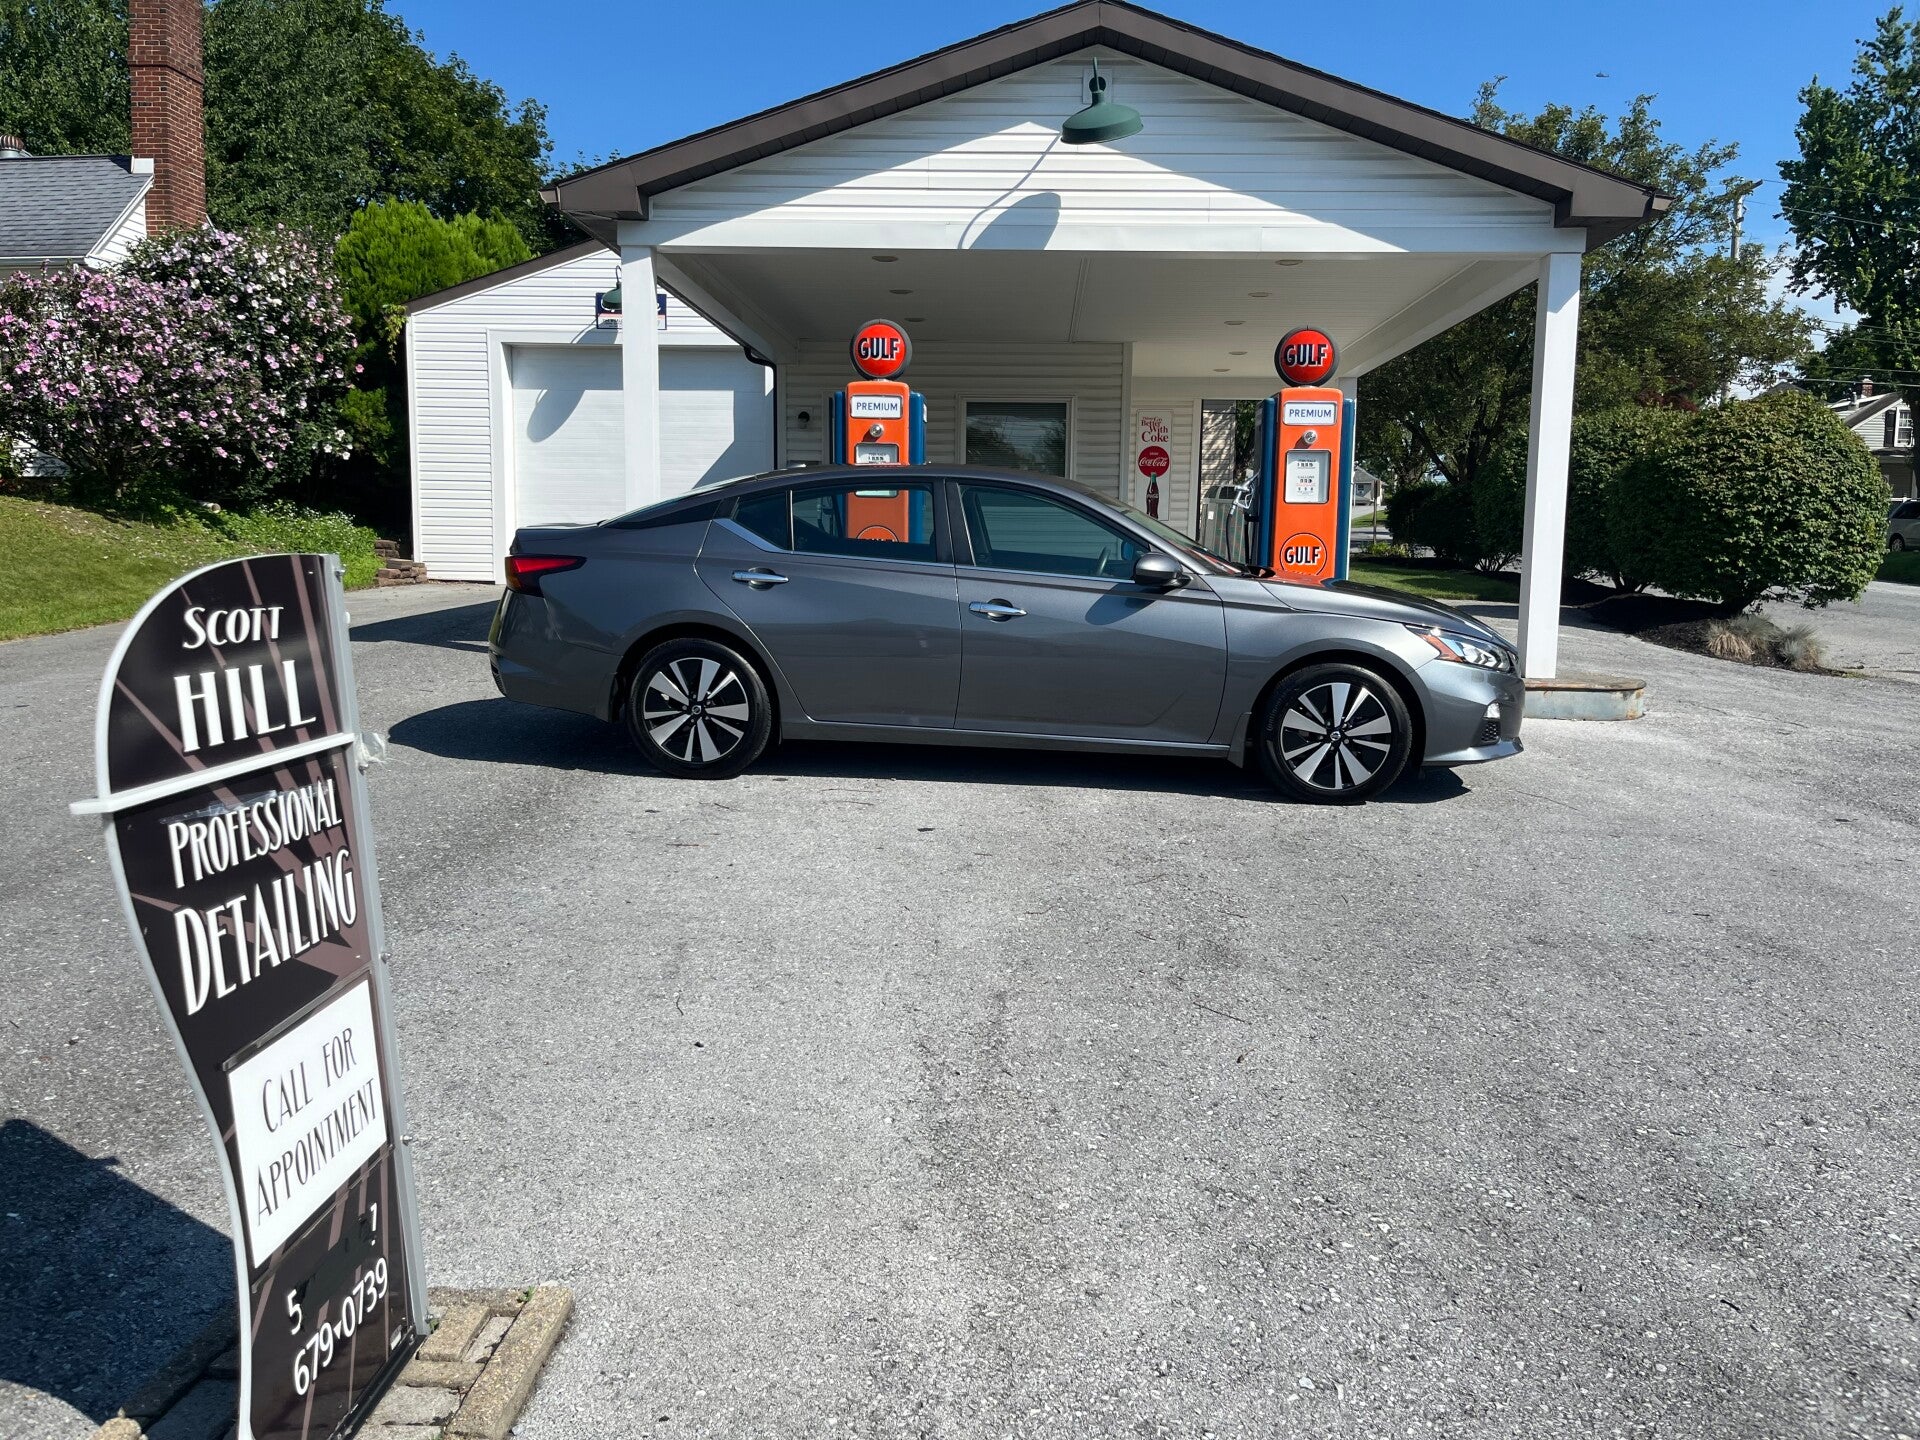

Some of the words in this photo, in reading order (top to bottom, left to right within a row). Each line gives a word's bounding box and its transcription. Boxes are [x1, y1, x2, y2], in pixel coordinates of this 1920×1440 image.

[858, 337, 900, 360] GULF
[1284, 343, 1328, 367] GULF
[856, 402, 898, 411] PREMIUM
[1289, 408, 1332, 418] PREMIUM
[1141, 431, 1168, 442] Coke
[1284, 546, 1321, 566] GULF
[182, 605, 284, 650] SCOTT
[173, 659, 317, 753] HILL
[168, 779, 342, 889] PROFESSIONAL
[173, 849, 358, 1016] DETAILING
[262, 1061, 314, 1133] CALL
[322, 1027, 357, 1088] FOR
[258, 1078, 376, 1227] APPOINTMENT
